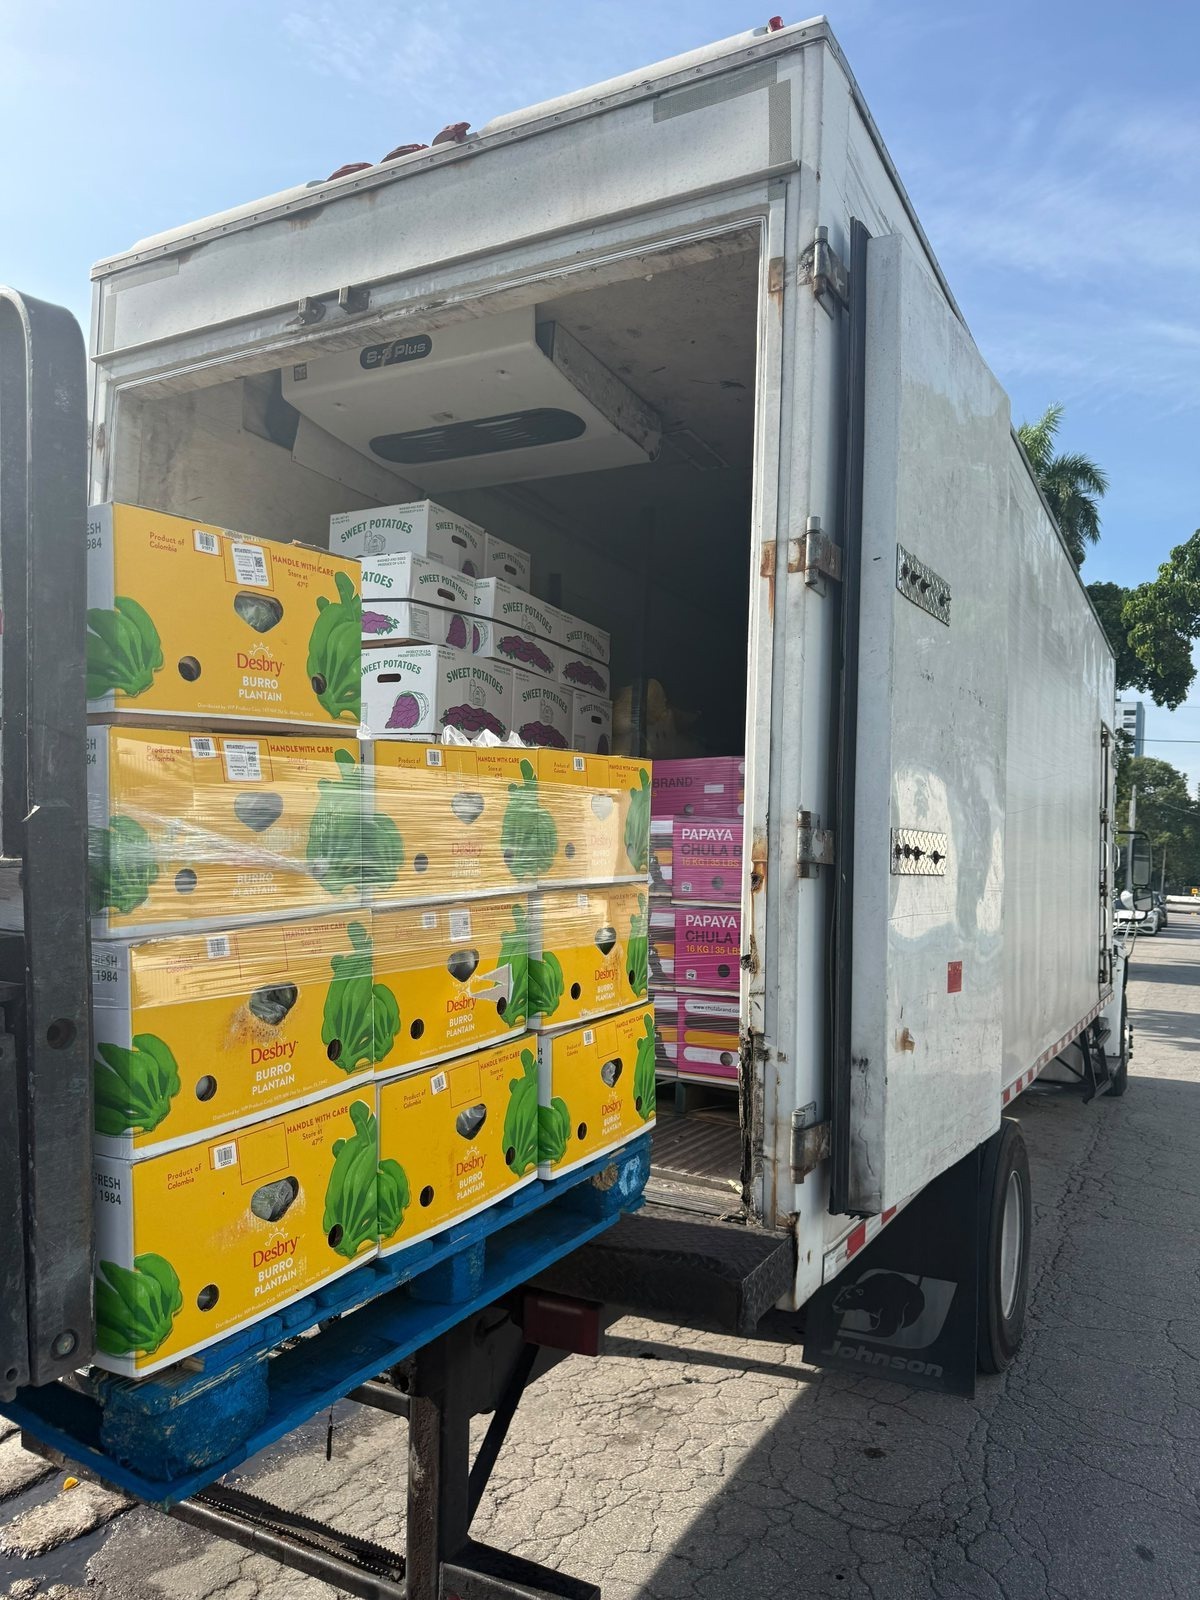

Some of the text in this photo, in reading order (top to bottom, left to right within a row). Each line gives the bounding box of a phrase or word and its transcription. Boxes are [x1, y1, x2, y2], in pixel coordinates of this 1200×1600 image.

[394, 343, 426, 358] Plus
[340, 522, 367, 542] SWEET
[370, 518, 413, 534] POTATOES
[436, 522, 478, 548] SWEET POTATOES
[149, 532, 176, 544] Product
[149, 541, 177, 553] Colombia
[272, 554, 334, 577] HANDLE WITH CARE
[288, 569, 302, 579] Store
[419, 574, 468, 600] SWEET POTATOES
[502, 602, 552, 634] SWEET POTATOES
[566, 630, 583, 642] SWEET
[237, 653, 282, 677] Desbry
[383, 660, 422, 674] POTATOES
[242, 676, 278, 689] BURRO
[446, 667, 504, 695] SWEET POTATOES
[238, 689, 282, 701] PLANTAIN
[522, 688, 568, 714] SWEET POTATOES
[146, 746, 174, 754] Product
[652, 776, 693, 788] BRAND
[682, 828, 733, 841] PAPAYA
[452, 843, 482, 857] Desbry
[682, 843, 728, 856] CHULA
[686, 915, 738, 928] PAPAYA
[685, 930, 733, 944] CHULA
[697, 945, 709, 953] KG
[96, 970, 118, 982] 1984
[595, 968, 617, 980] Desbry
[597, 983, 614, 993] BURRO
[596, 992, 616, 1002] PLANTAIN
[446, 996, 476, 1013] Desbry
[450, 1014, 473, 1027] BURRO
[446, 1024, 475, 1038] PLANTAIN
[251, 1040, 298, 1064] Desbry
[480, 1050, 520, 1071] HANDLE WITH CARE
[256, 1062, 292, 1082] BURRO
[252, 1074, 295, 1095] PLANTAIN
[403, 1092, 421, 1102] Product
[403, 1100, 421, 1109] Colombia
[602, 1099, 623, 1116] Desbry
[287, 1106, 348, 1134] HANDLE WITH CARE
[604, 1113, 620, 1126] BURRO
[602, 1120, 622, 1136] PLANTAIN
[302, 1132, 316, 1140] Store
[456, 1154, 487, 1176] Desbry
[168, 1163, 202, 1182] Product of
[168, 1177, 194, 1190] Colombia
[460, 1171, 483, 1189] BURRO
[100, 1190, 121, 1205] 1984
[456, 1180, 485, 1201] PLANTAIN
[253, 1236, 300, 1268] Desbry
[258, 1257, 294, 1282] BURRO
[254, 1269, 297, 1297] PLANTAIN
[820, 1340, 943, 1378] Johnson
